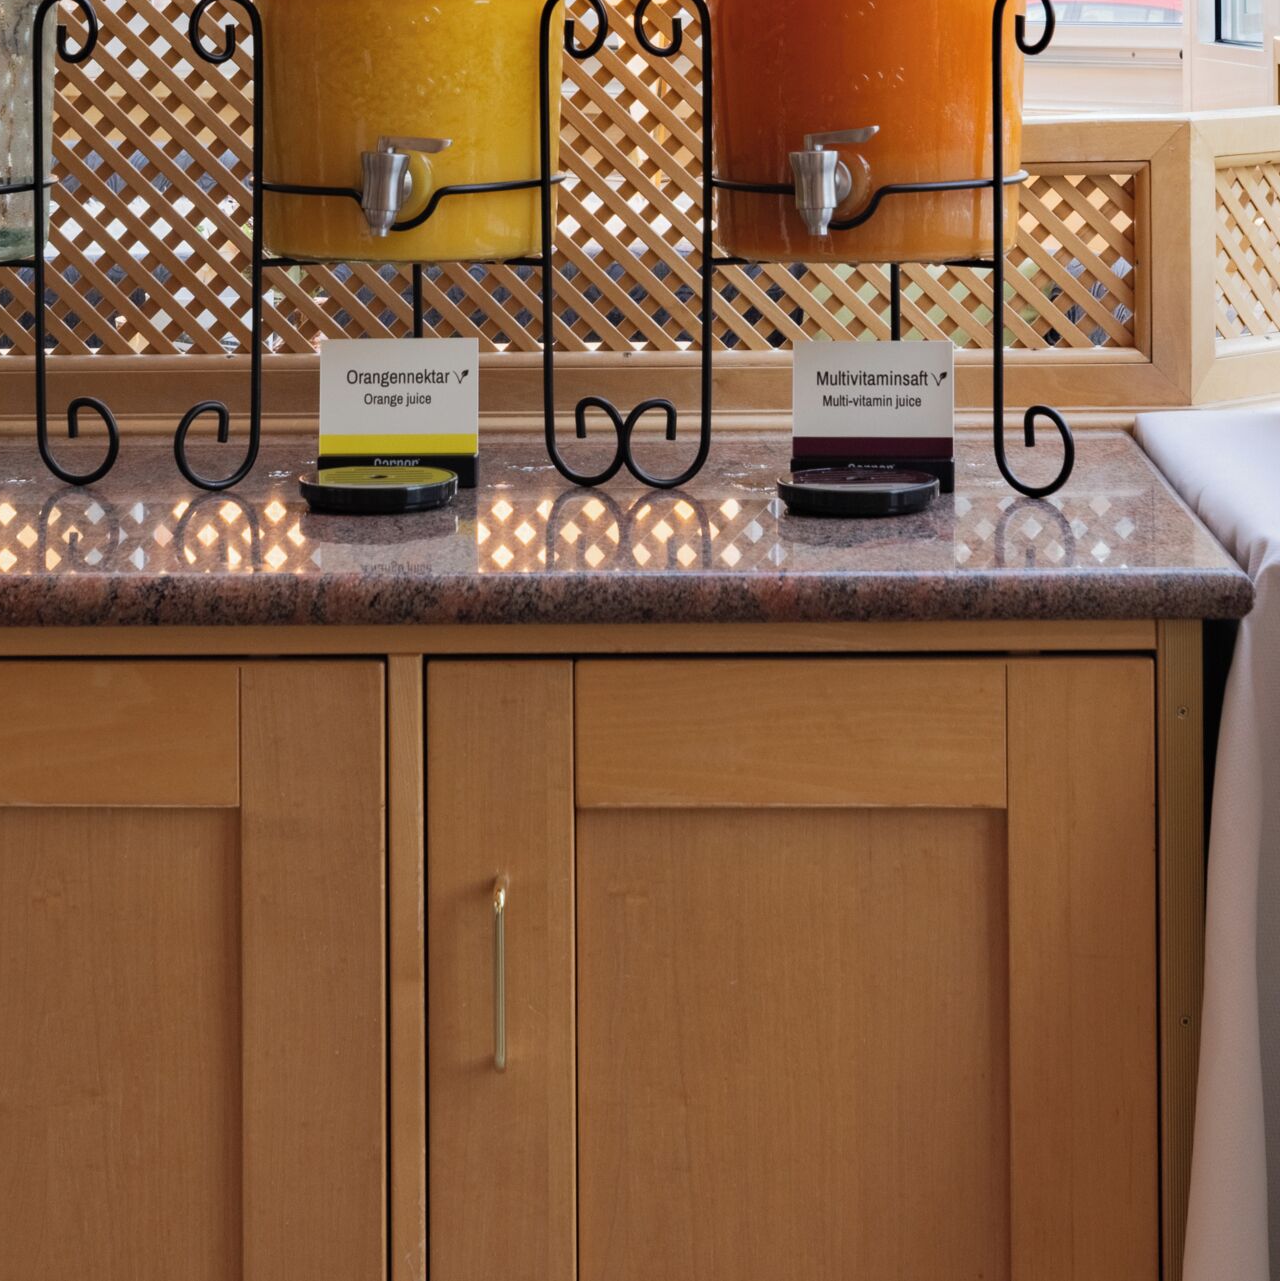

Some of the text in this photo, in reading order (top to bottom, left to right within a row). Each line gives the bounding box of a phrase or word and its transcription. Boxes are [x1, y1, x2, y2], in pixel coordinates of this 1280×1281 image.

[346, 368, 450, 387] Orangennektar
[816, 370, 928, 386] Multivitaminsaft
[363, 392, 431, 407] Orange juice
[822, 394, 922, 409] Multi-vitamin juice
